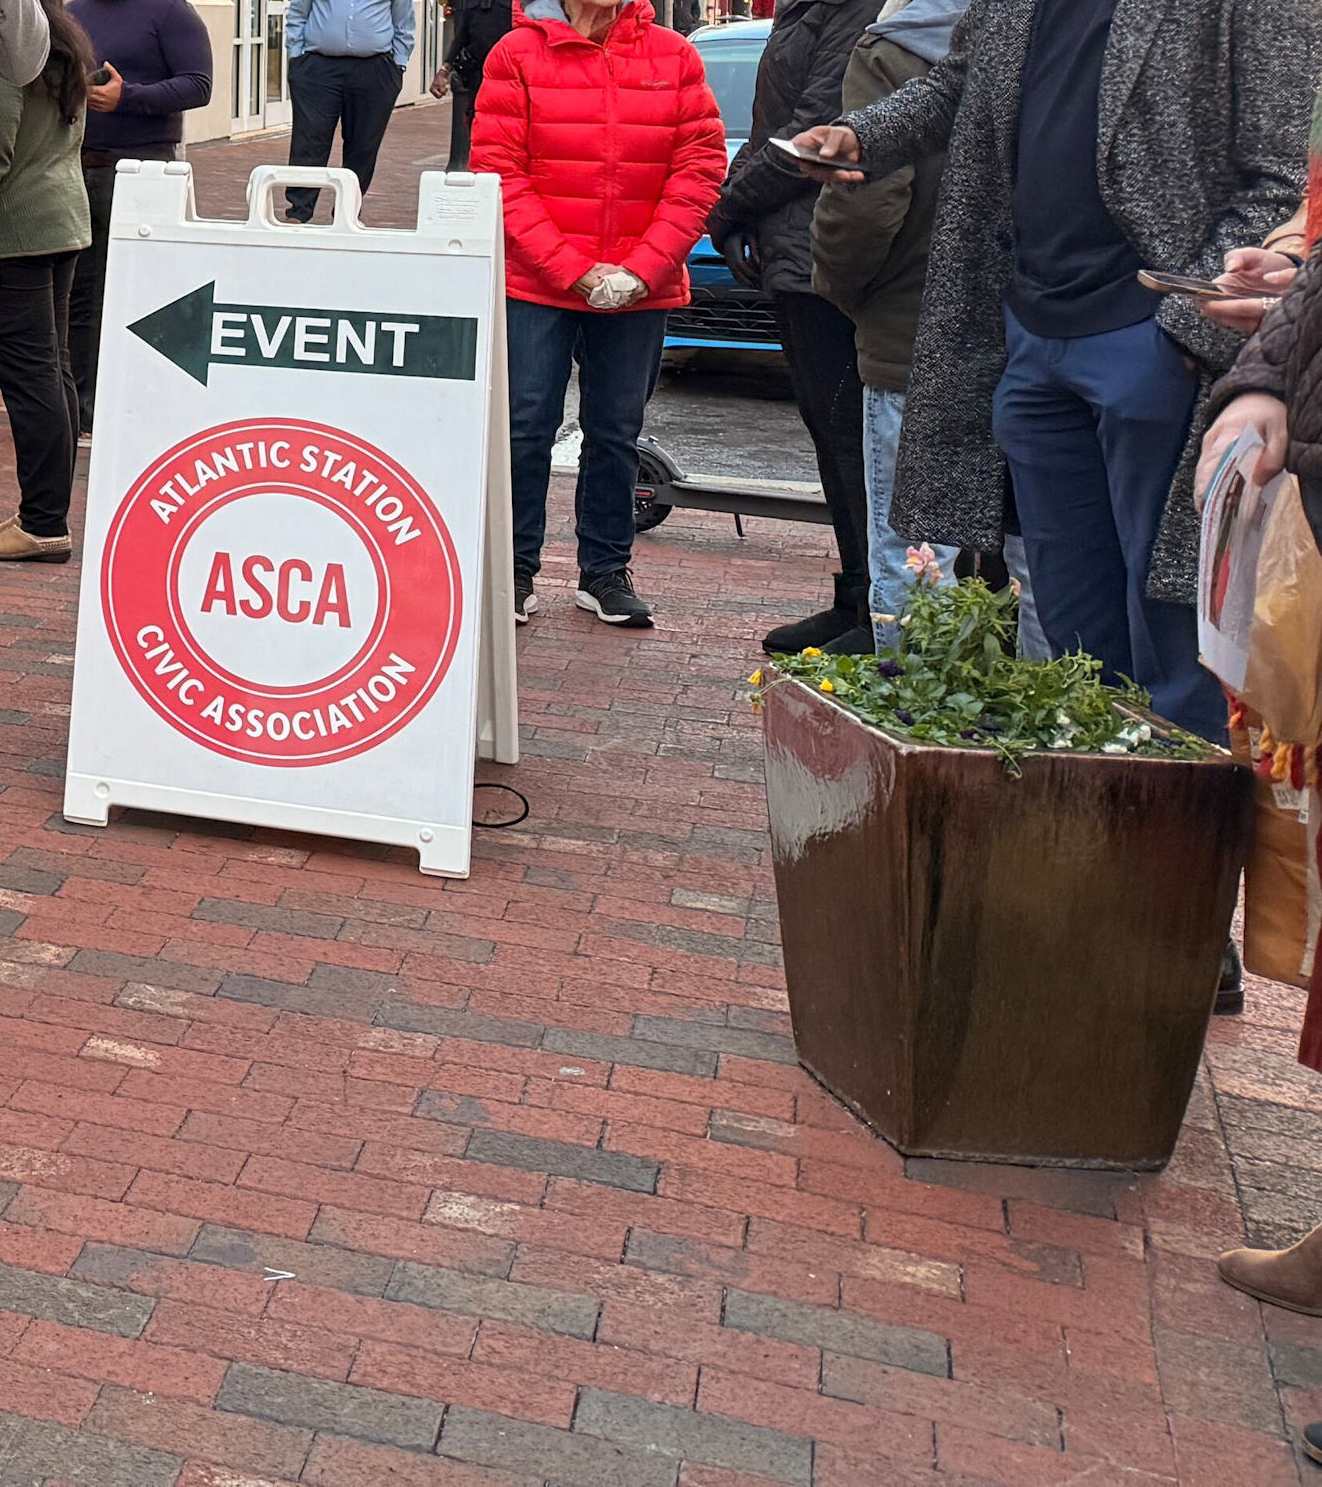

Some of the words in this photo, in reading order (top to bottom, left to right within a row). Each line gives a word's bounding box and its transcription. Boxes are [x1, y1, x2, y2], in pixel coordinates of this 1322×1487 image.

[210, 312, 420, 368] EVENT
[148, 440, 290, 525] ATLANTIC
[302, 446, 421, 547] STATION
[200, 551, 352, 629] ASCA
[136, 624, 208, 707] CIVIC
[201, 652, 417, 742] ASSOCIATION
